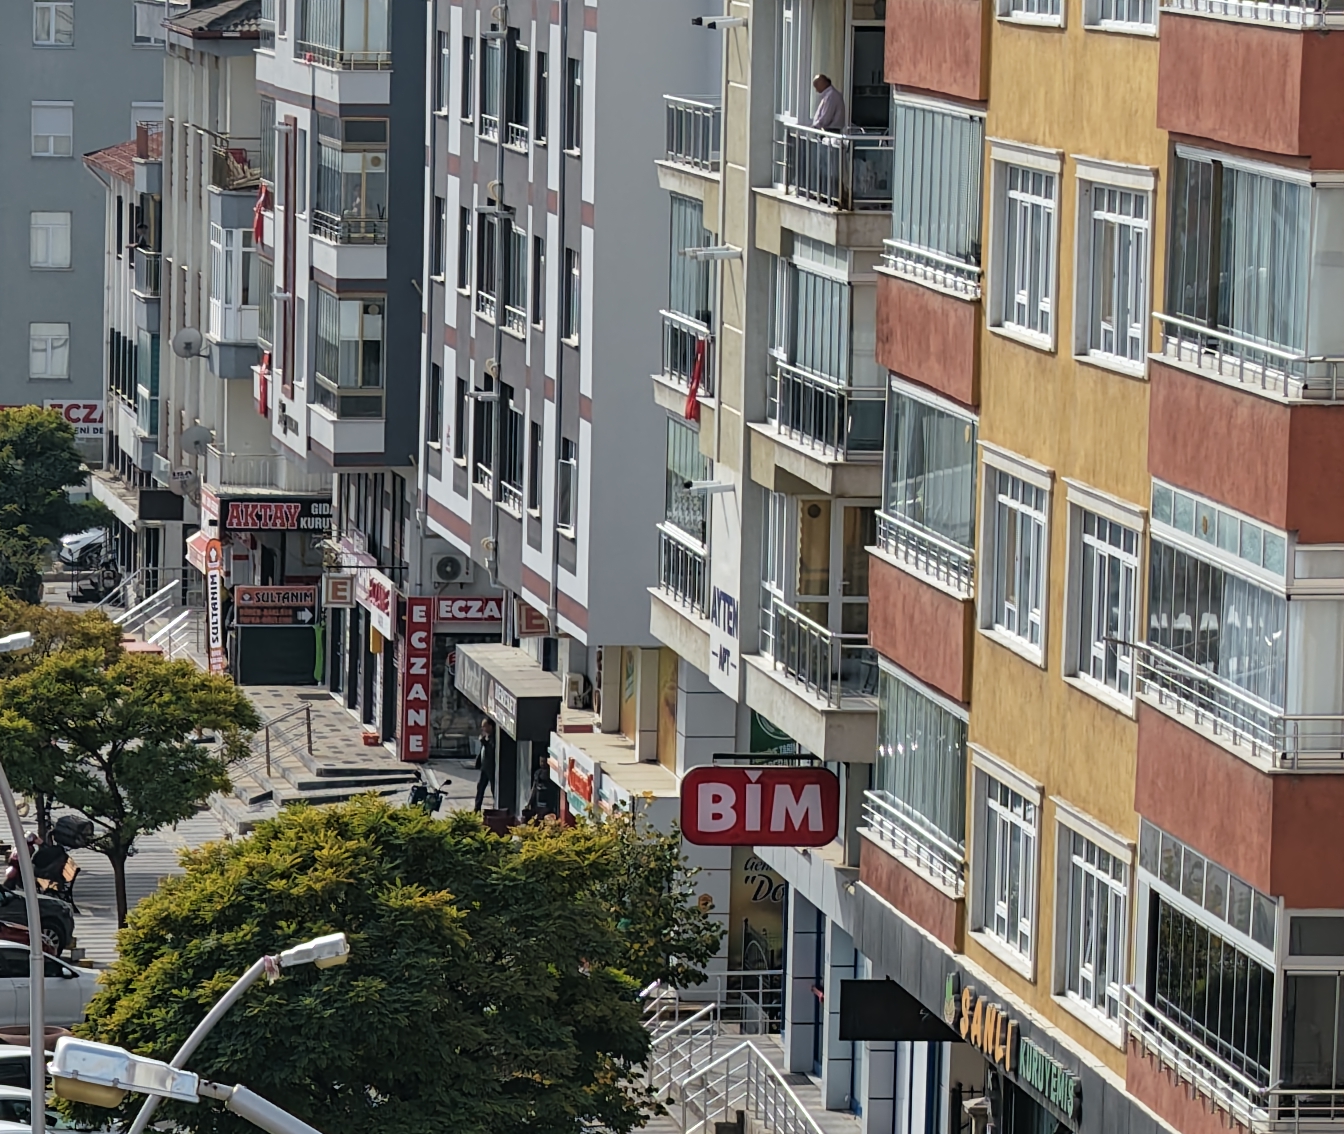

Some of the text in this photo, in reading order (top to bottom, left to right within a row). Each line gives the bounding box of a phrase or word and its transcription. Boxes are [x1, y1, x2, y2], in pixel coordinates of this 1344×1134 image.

[226, 502, 302, 530] AKTAY
[212, 574, 220, 644] SULTANIM
[255, 591, 313, 604] SULTANIM
[331, 581, 347, 600] E
[439, 600, 503, 618] ECZA
[710, 585, 738, 639] AYTEN
[406, 605, 429, 752] ECZANE
[697, 770, 824, 832] BİM
[1019, 1036, 1077, 1119] KURUYEMİŞ
